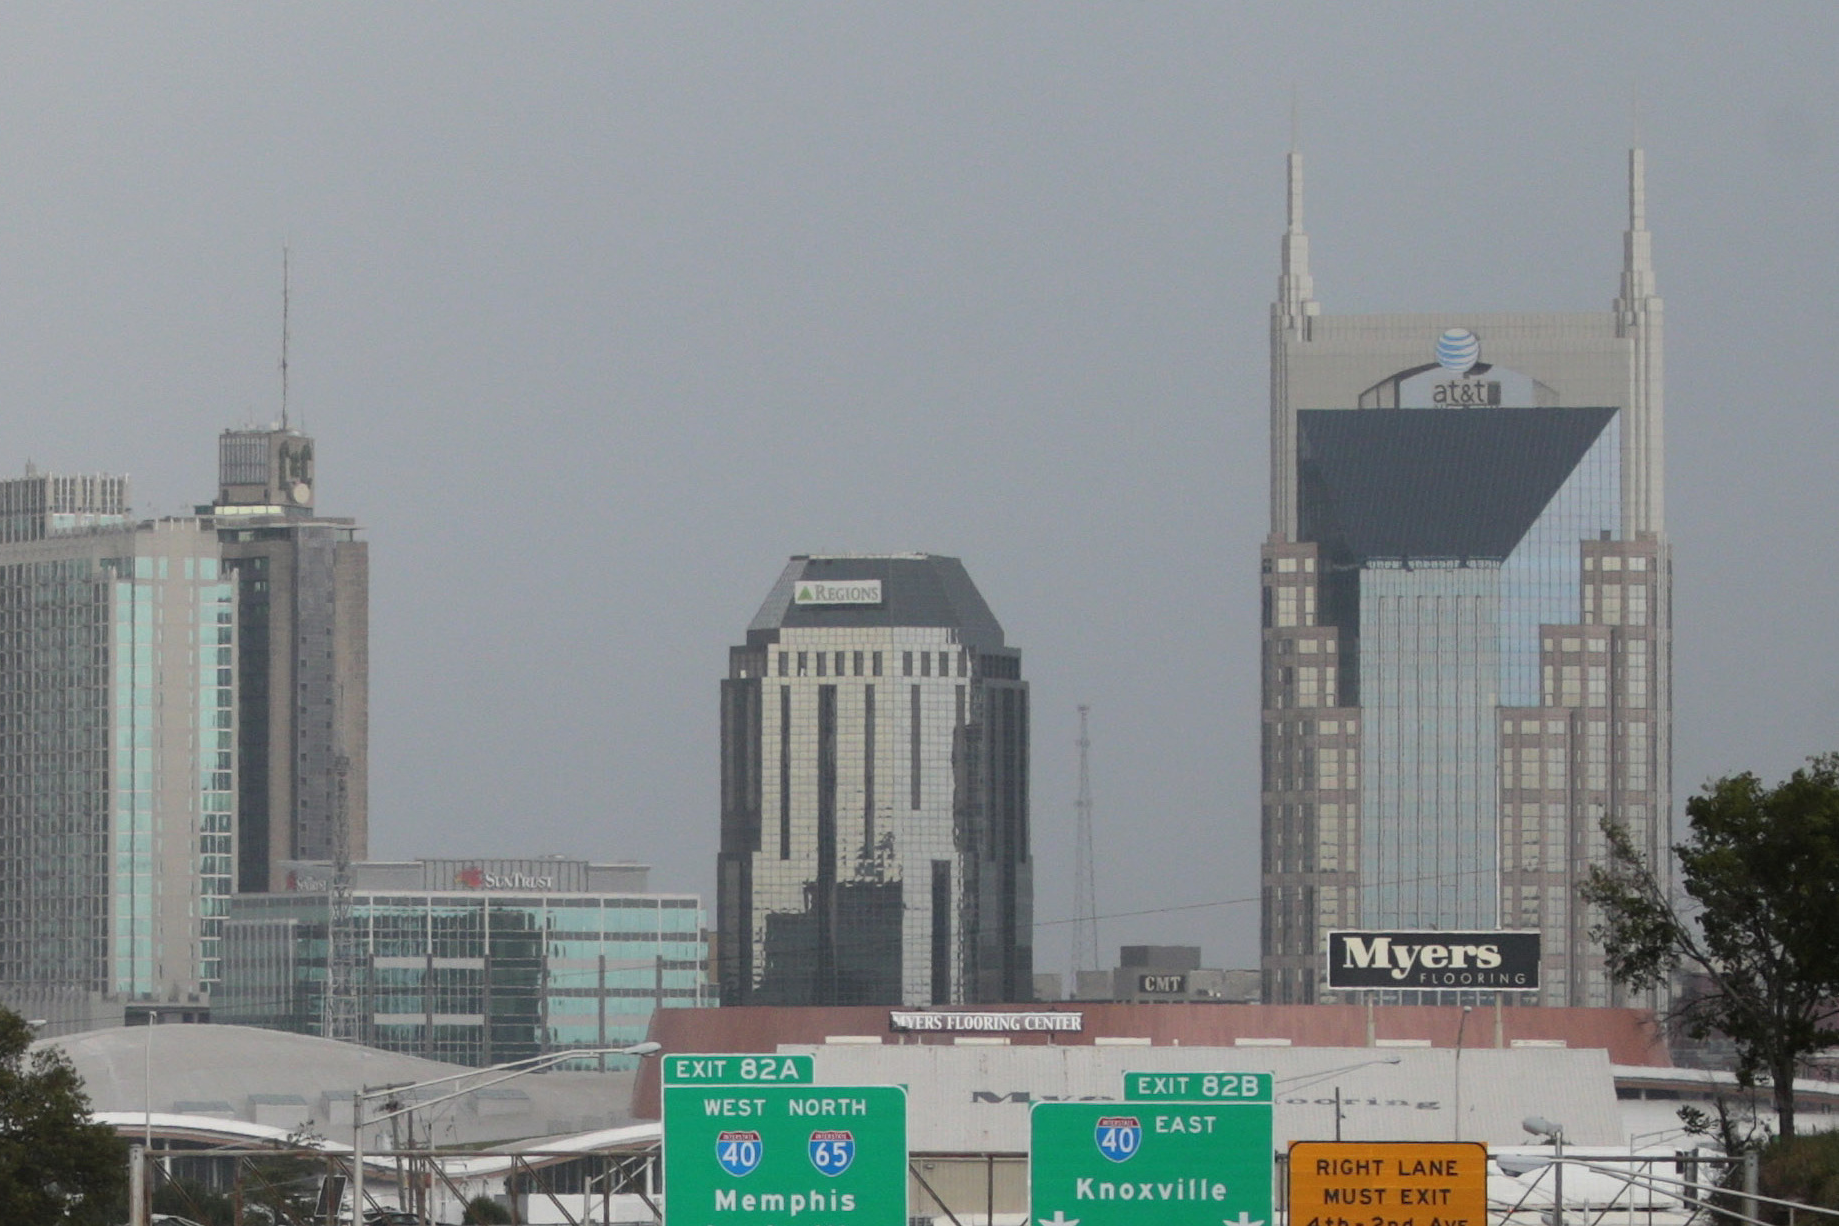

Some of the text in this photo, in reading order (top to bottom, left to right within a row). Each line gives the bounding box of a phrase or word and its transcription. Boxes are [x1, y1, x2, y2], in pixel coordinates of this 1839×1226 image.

[1433, 380, 1485, 403] at&t
[1342, 936, 1502, 979] Myers
[1144, 976, 1180, 992] CMT
[1420, 972, 1526, 985] FLOORING
[892, 1015, 1081, 1030] MYERS FLOORING CENTER
[676, 1058, 799, 1080] EXIT 82A
[1138, 1076, 1259, 1098] EXIT 82B
[703, 1098, 867, 1116] WEST NORTH
[1155, 1116, 1217, 1134] EAST
[1101, 1127, 1135, 1154] 40
[722, 1142, 756, 1167] 40
[815, 1142, 848, 1167] 65
[1316, 1159, 1458, 1177] RIGHT LANE
[1076, 1177, 1227, 1201] Knoxville
[1324, 1188, 1451, 1205] MUST EXIT
[715, 1189, 856, 1217] Memphis
